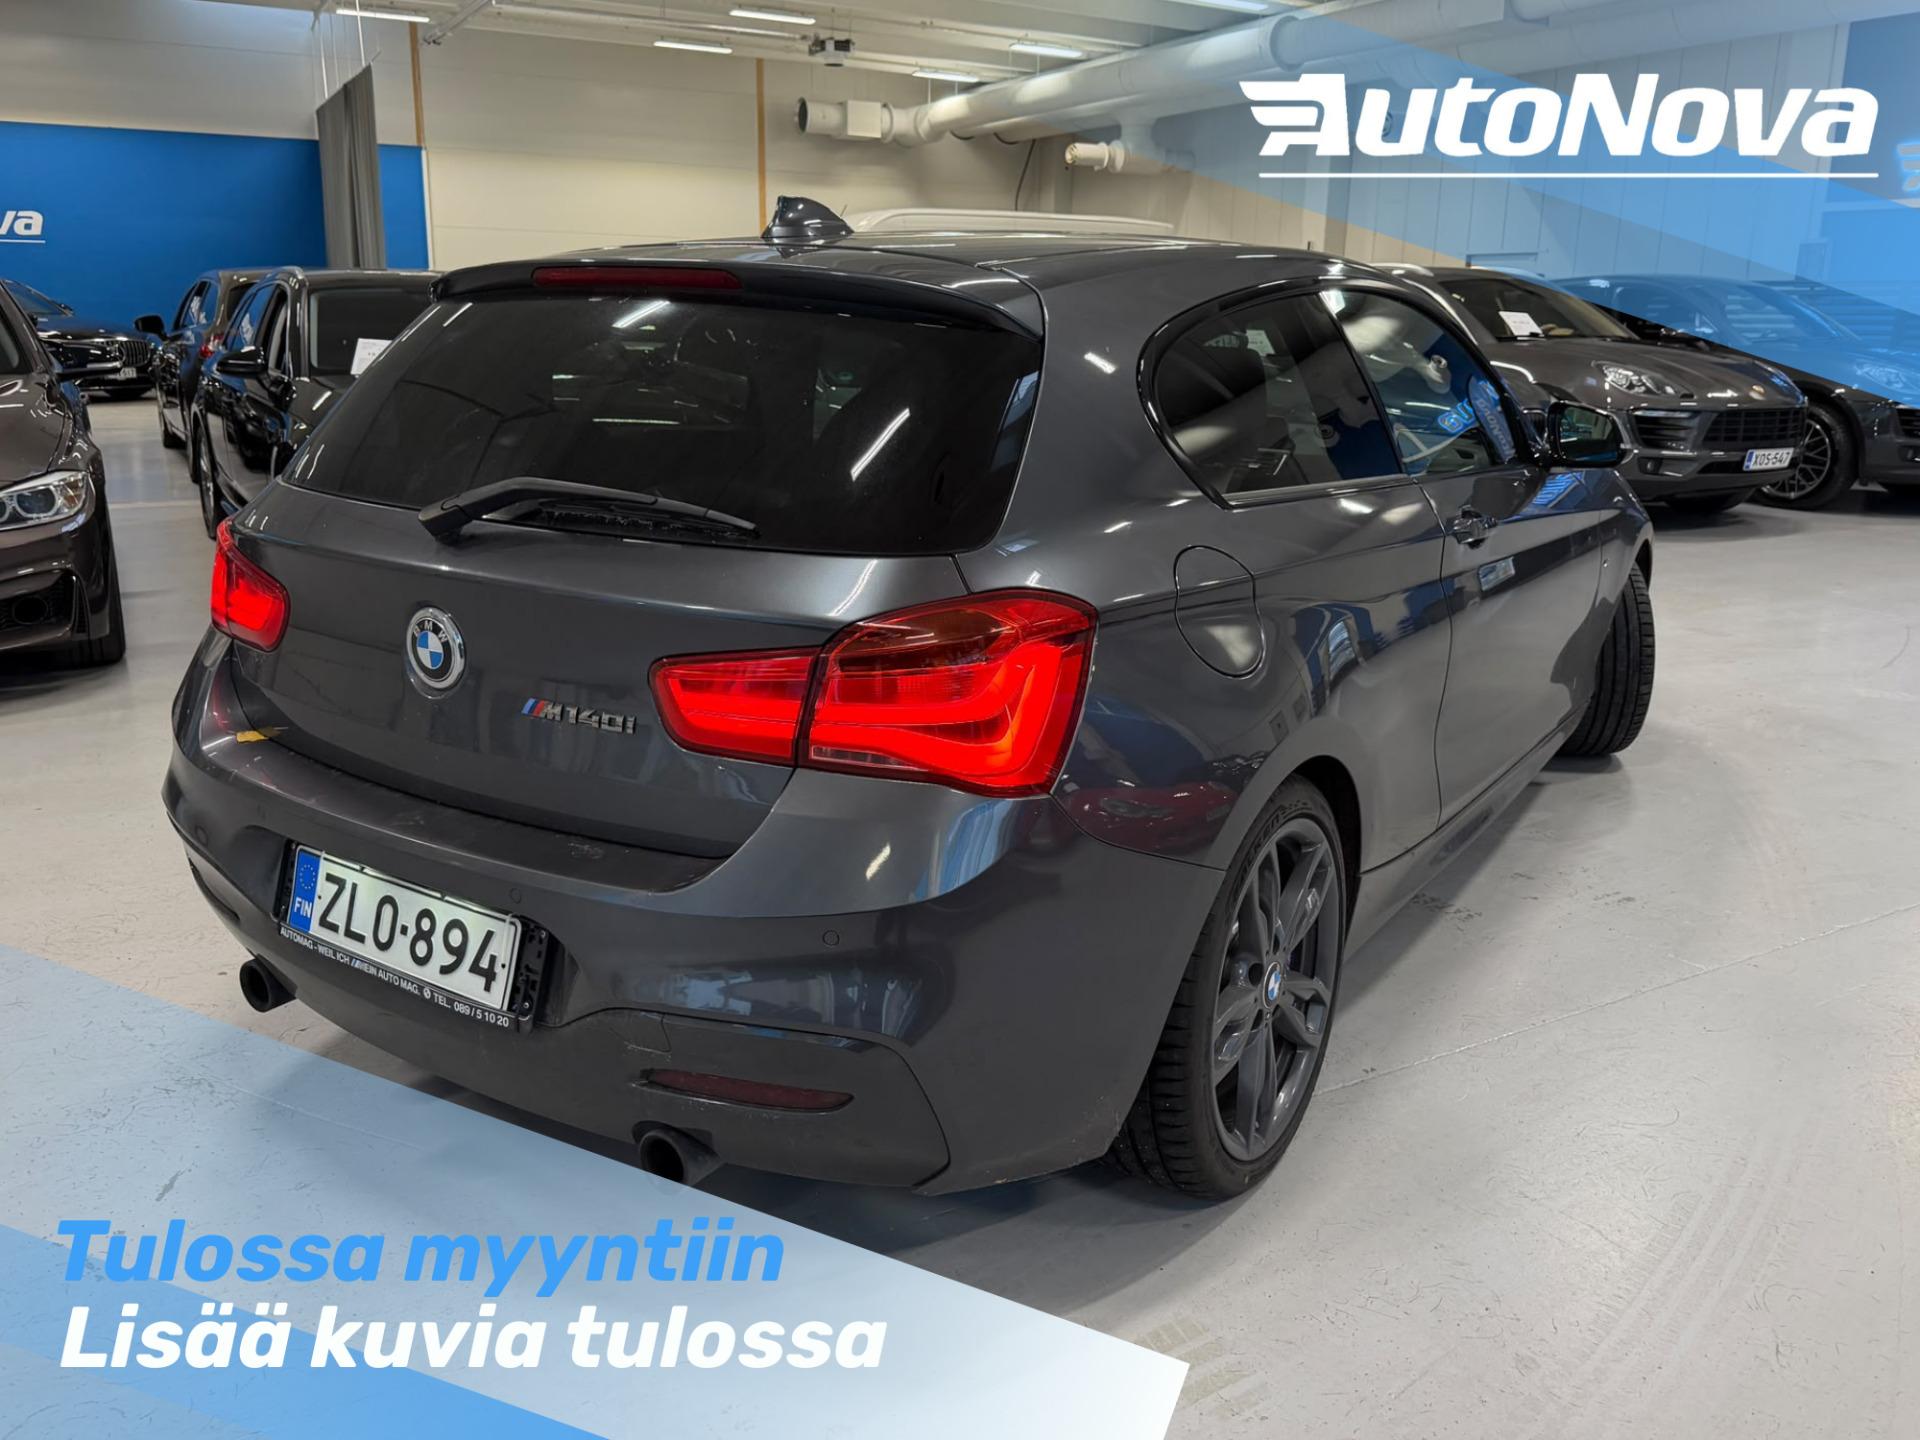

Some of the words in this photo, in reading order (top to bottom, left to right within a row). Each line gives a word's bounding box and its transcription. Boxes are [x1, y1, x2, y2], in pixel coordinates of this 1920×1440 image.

[413, 619, 449, 643] BMW
[293, 897, 314, 919] FIN
[317, 872, 498, 993] ZLO-894
[280, 926, 313, 950] AUTOMAG
[318, 944, 336, 960] WEIL
[336, 952, 350, 965] ICH
[378, 970, 400, 986] AUTO
